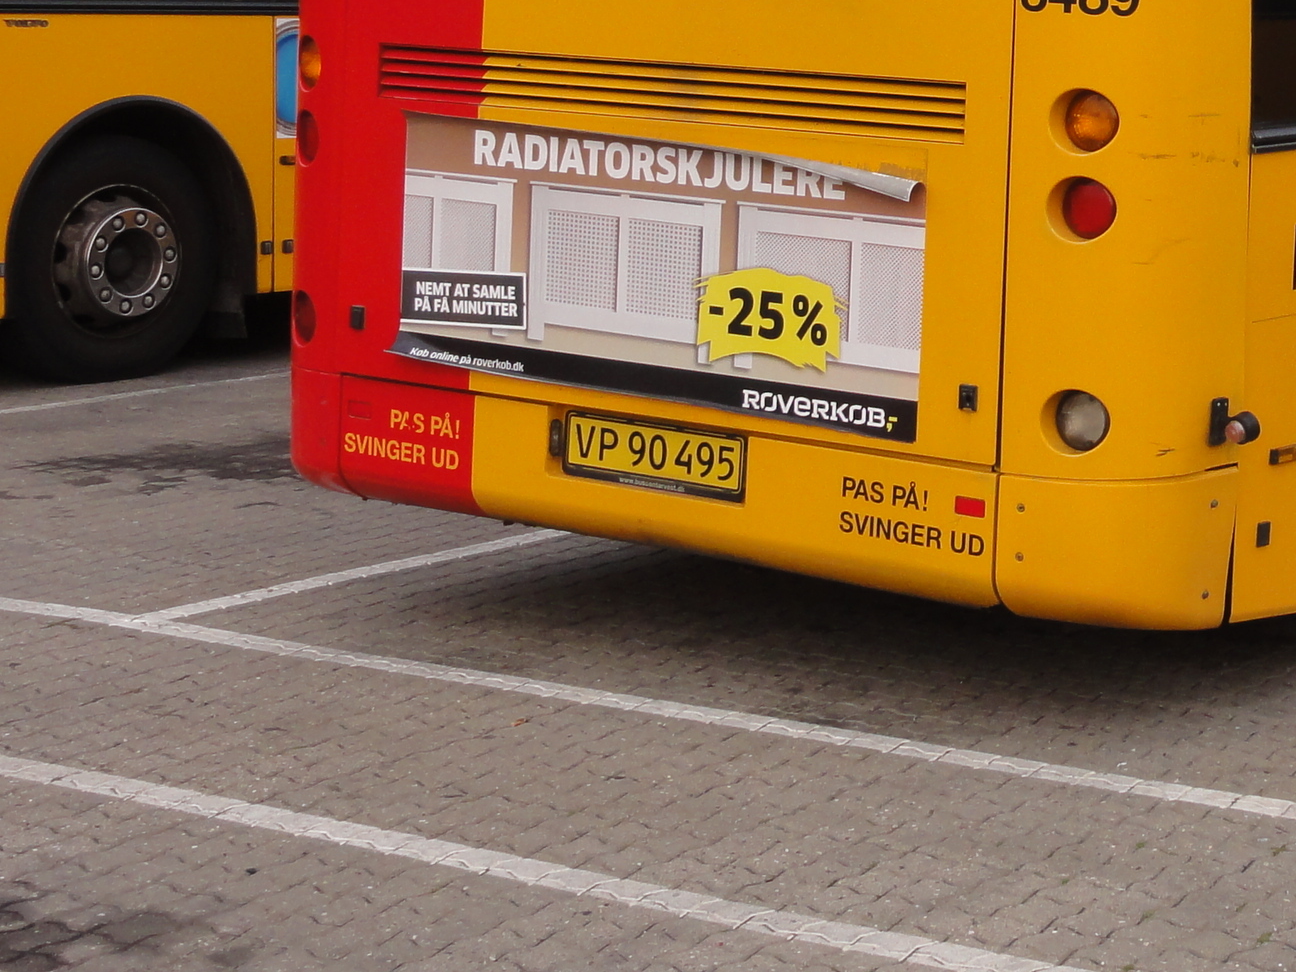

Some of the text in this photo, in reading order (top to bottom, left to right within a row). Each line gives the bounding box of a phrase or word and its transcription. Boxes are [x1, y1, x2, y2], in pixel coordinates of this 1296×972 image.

[473, 129, 846, 201] RADIATORSKJULERE
[414, 296, 518, 317] PÅ FÅ MINUTTER
[416, 281, 516, 300] NEMT AT SAMLE
[709, 287, 827, 346] -25%
[410, 347, 429, 358] Køb
[430, 351, 459, 363] online
[459, 354, 471, 365] på
[390, 409, 460, 439] PAS PÅ!
[344, 432, 460, 470] SVINGER UD
[576, 424, 735, 481] VP 90 495
[842, 476, 928, 512] PAS PÅ!
[839, 510, 985, 557] SVINGER UD
